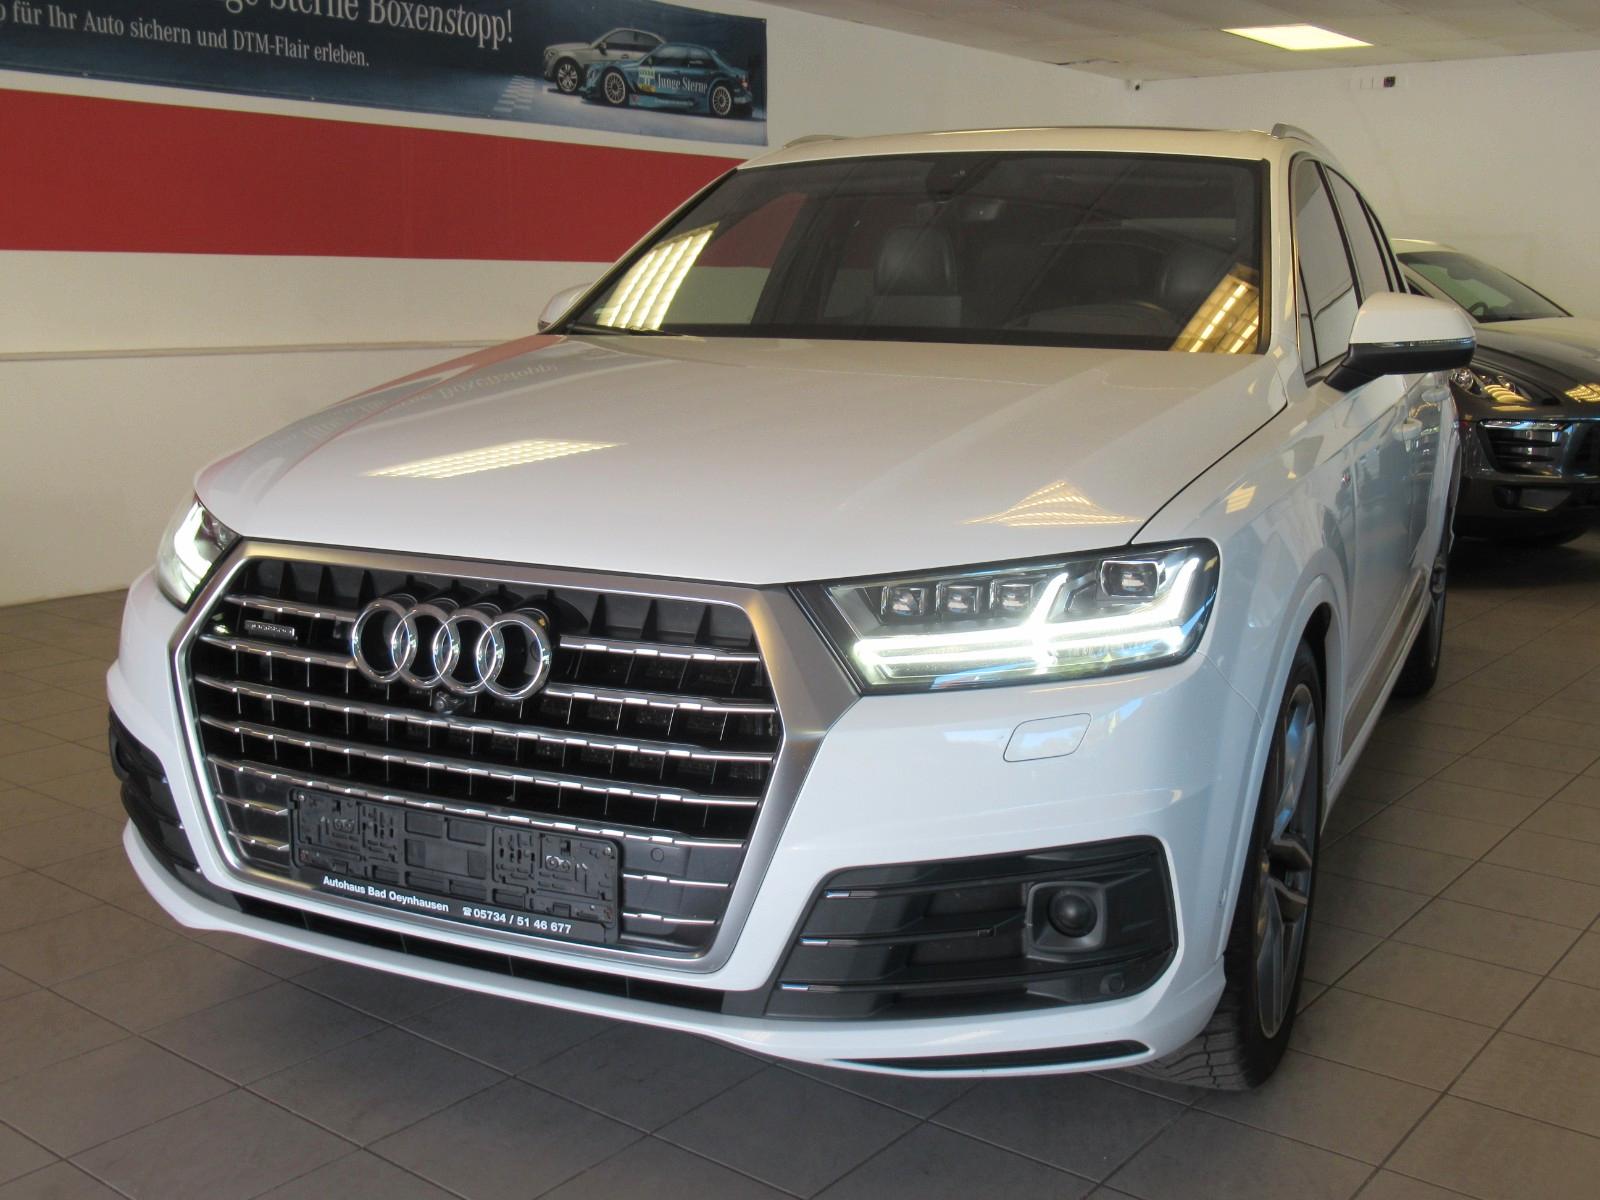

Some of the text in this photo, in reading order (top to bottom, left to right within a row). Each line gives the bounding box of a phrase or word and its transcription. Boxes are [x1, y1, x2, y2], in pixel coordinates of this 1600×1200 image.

[13, 0, 42, 25] für
[48, 4, 78, 30] Ihr
[83, 10, 125, 36] Auto
[130, 17, 191, 45] sichern
[197, 28, 228, 49] und
[233, 29, 310, 60] DTM-Flair
[314, 42, 370, 67] erleben.
[368, 0, 513, 50] Boxenstopp!
[323, 875, 366, 895] Autohaus
[367, 886, 387, 901] Bad
[389, 890, 449, 912] Oeynhausen
[473, 909, 507, 925] 05734
[516, 916, 531, 928] 51
[533, 919, 548, 931] 46
[550, 921, 572, 935] 677
